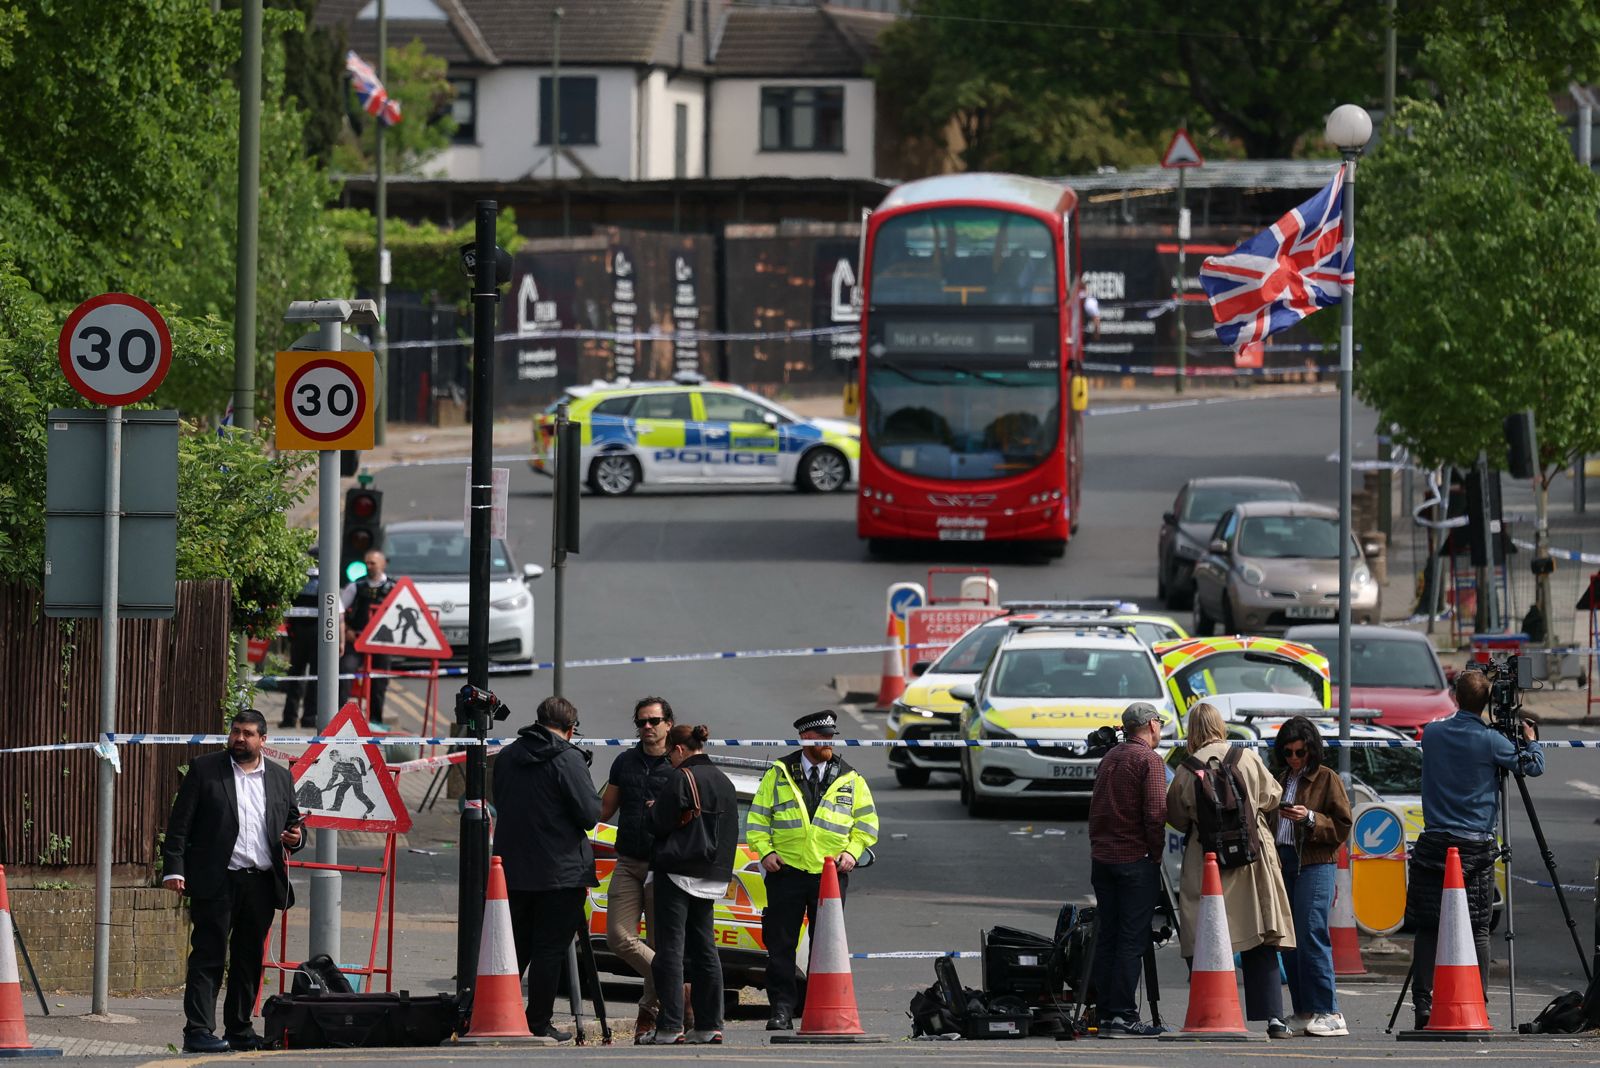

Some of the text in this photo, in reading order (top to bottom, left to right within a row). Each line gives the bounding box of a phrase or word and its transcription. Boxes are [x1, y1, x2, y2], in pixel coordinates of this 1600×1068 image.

[77, 326, 156, 374] 30
[933, 332, 975, 348] Service
[297, 383, 355, 417] 30
[654, 448, 778, 466] POLICE
[326, 594, 335, 641] S166
[1053, 765, 1083, 777] BX20
